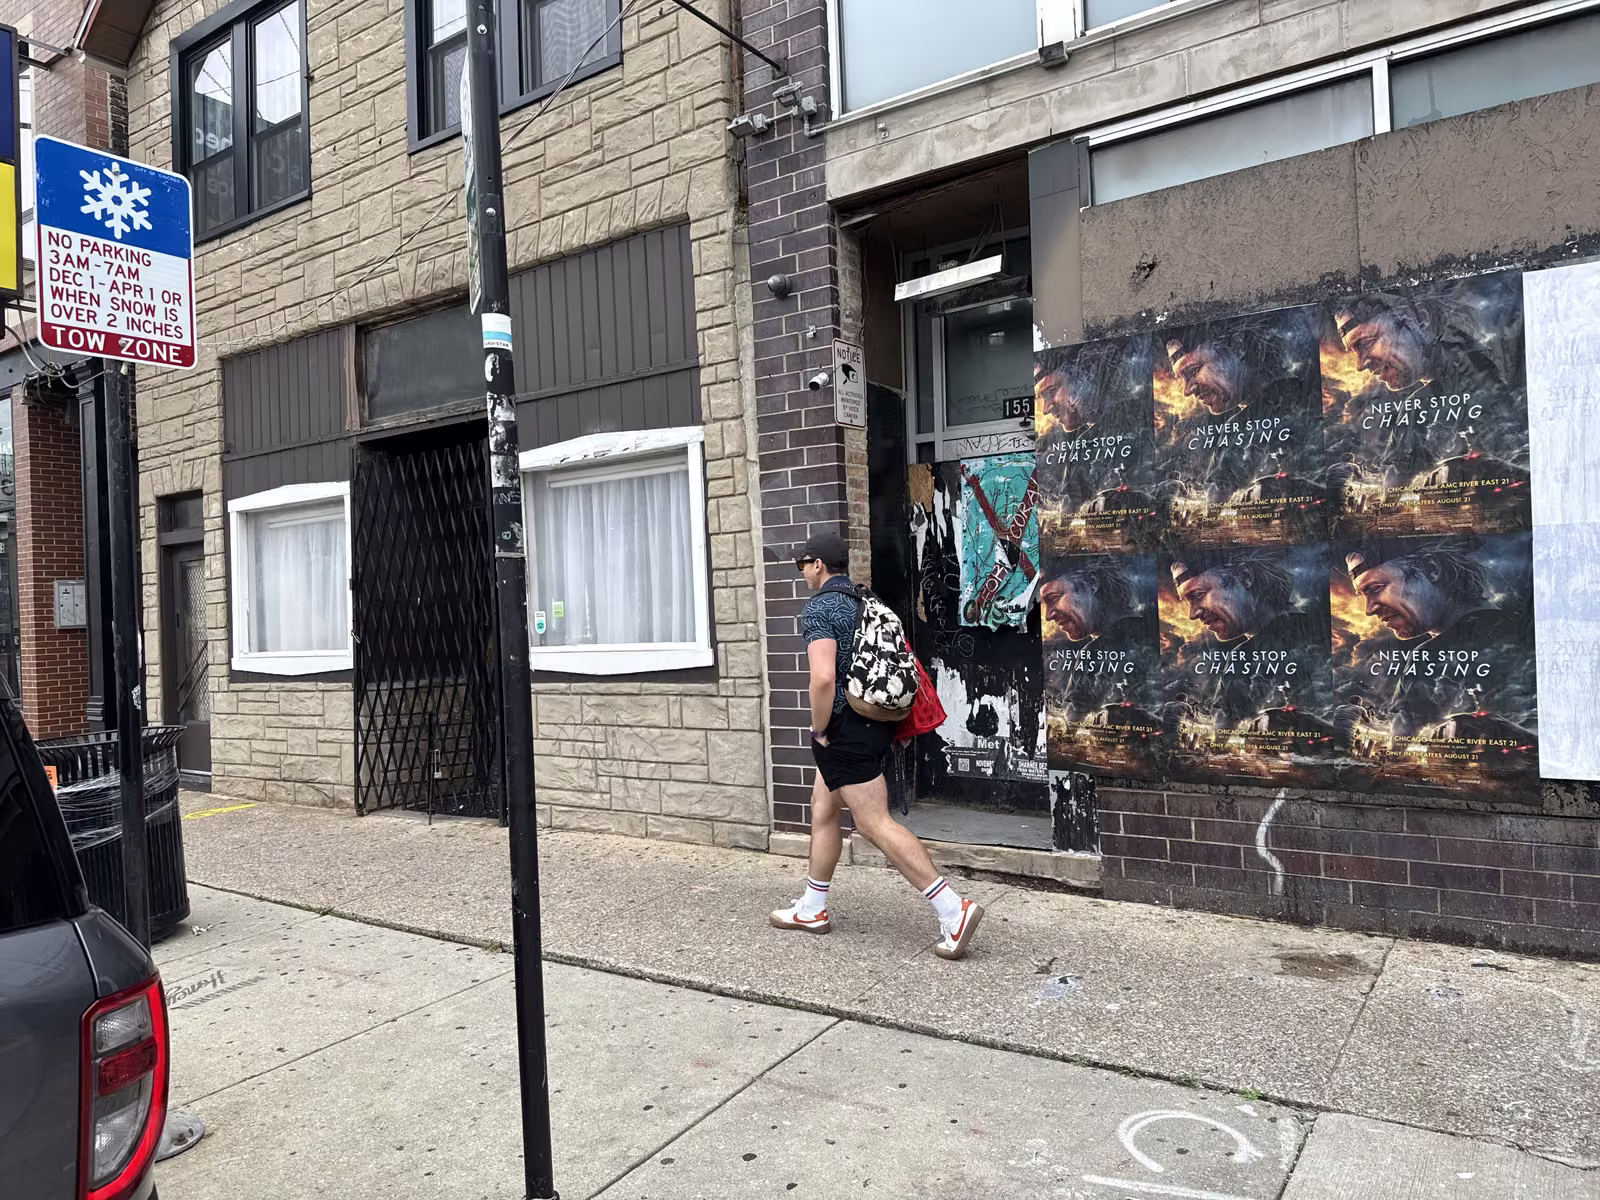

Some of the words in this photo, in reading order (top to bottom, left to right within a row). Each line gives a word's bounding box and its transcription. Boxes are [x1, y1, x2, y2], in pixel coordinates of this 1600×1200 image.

[48, 231, 72, 249] NO
[80, 238, 152, 267] PARKING
[50, 267, 83, 286] DEC
[149, 288, 154, 301] 1
[162, 290, 182, 306] OR
[51, 286, 101, 307] WHEN
[110, 297, 156, 318] SNOW
[165, 307, 178, 322] IS
[51, 303, 97, 324] OVER
[107, 314, 118, 328] 2
[126, 317, 183, 339] INCHES
[51, 326, 106, 351] TOW
[120, 337, 182, 364] ZONE
[837, 348, 861, 363] NOTICE
[1371, 398, 1422, 415] NEVER
[1430, 393, 1471, 408] STOP
[1197, 422, 1239, 436] NEVER
[1246, 417, 1281, 431] STOP
[1362, 404, 1482, 430] CHASING
[1052, 439, 1087, 451] NEVER
[1093, 436, 1123, 447] STOP
[1188, 428, 1290, 450] CHASING
[1046, 445, 1131, 465] CHASING
[1056, 650, 1091, 660] NEVER
[1097, 651, 1126, 660] STOP
[1203, 651, 1246, 661] NEVER
[1252, 651, 1287, 661] STOP
[1379, 650, 1430, 661] NEVER
[1438, 650, 1479, 661] STOP
[1049, 660, 1134, 673] CHASING
[1194, 662, 1297, 674] CHASING
[1370, 663, 1490, 677] CHASING
[977, 739, 1000, 749] Met
